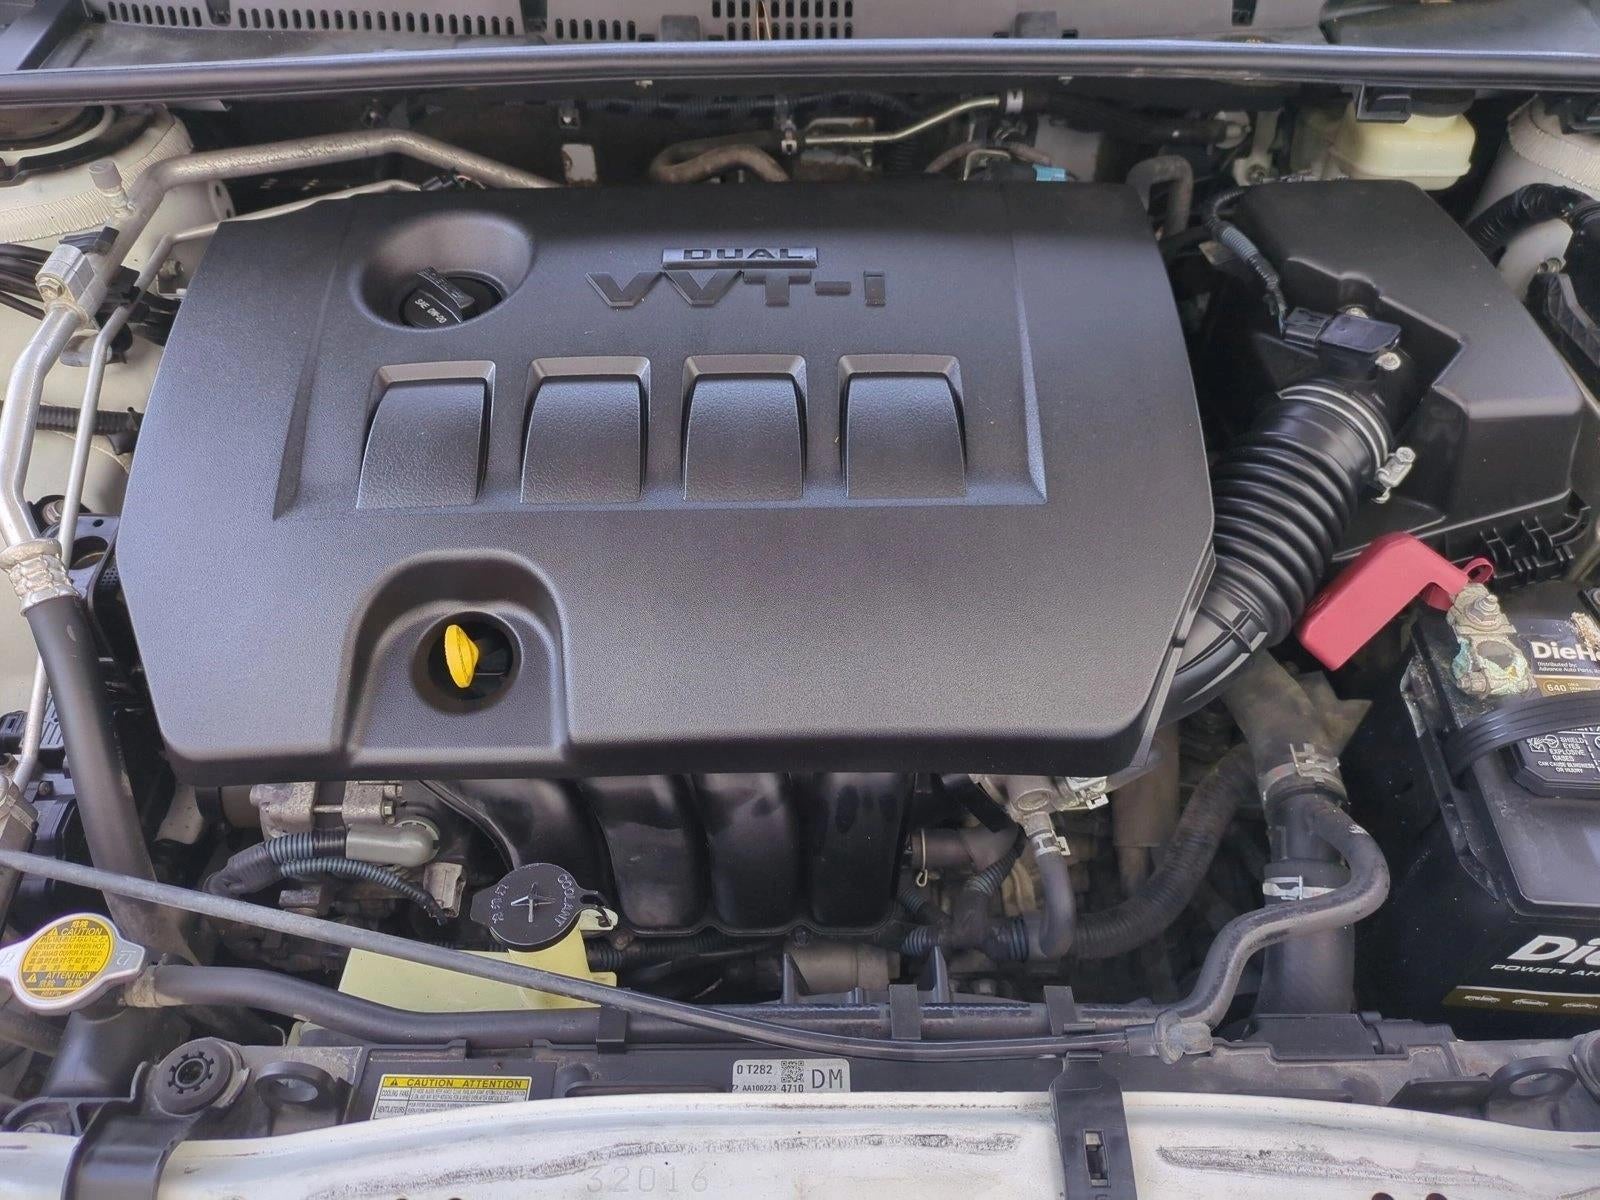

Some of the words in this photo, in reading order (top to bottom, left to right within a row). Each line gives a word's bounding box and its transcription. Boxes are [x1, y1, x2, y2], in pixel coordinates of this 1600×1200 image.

[683, 248, 804, 260] DUAL
[414, 298, 431, 310] SAE
[1546, 684, 1567, 692] 640
[61, 928, 103, 936] CAUTION
[1490, 964, 1567, 975] POWER
[45, 972, 91, 980] ATTENTION
[746, 1064, 773, 1075] T282
[406, 1078, 453, 1087] CAUTION
[462, 1080, 522, 1089] ATTENTION
[811, 1068, 843, 1089] DM
[742, 1084, 777, 1092] AA100223
[780, 1084, 804, 1093] 4710
